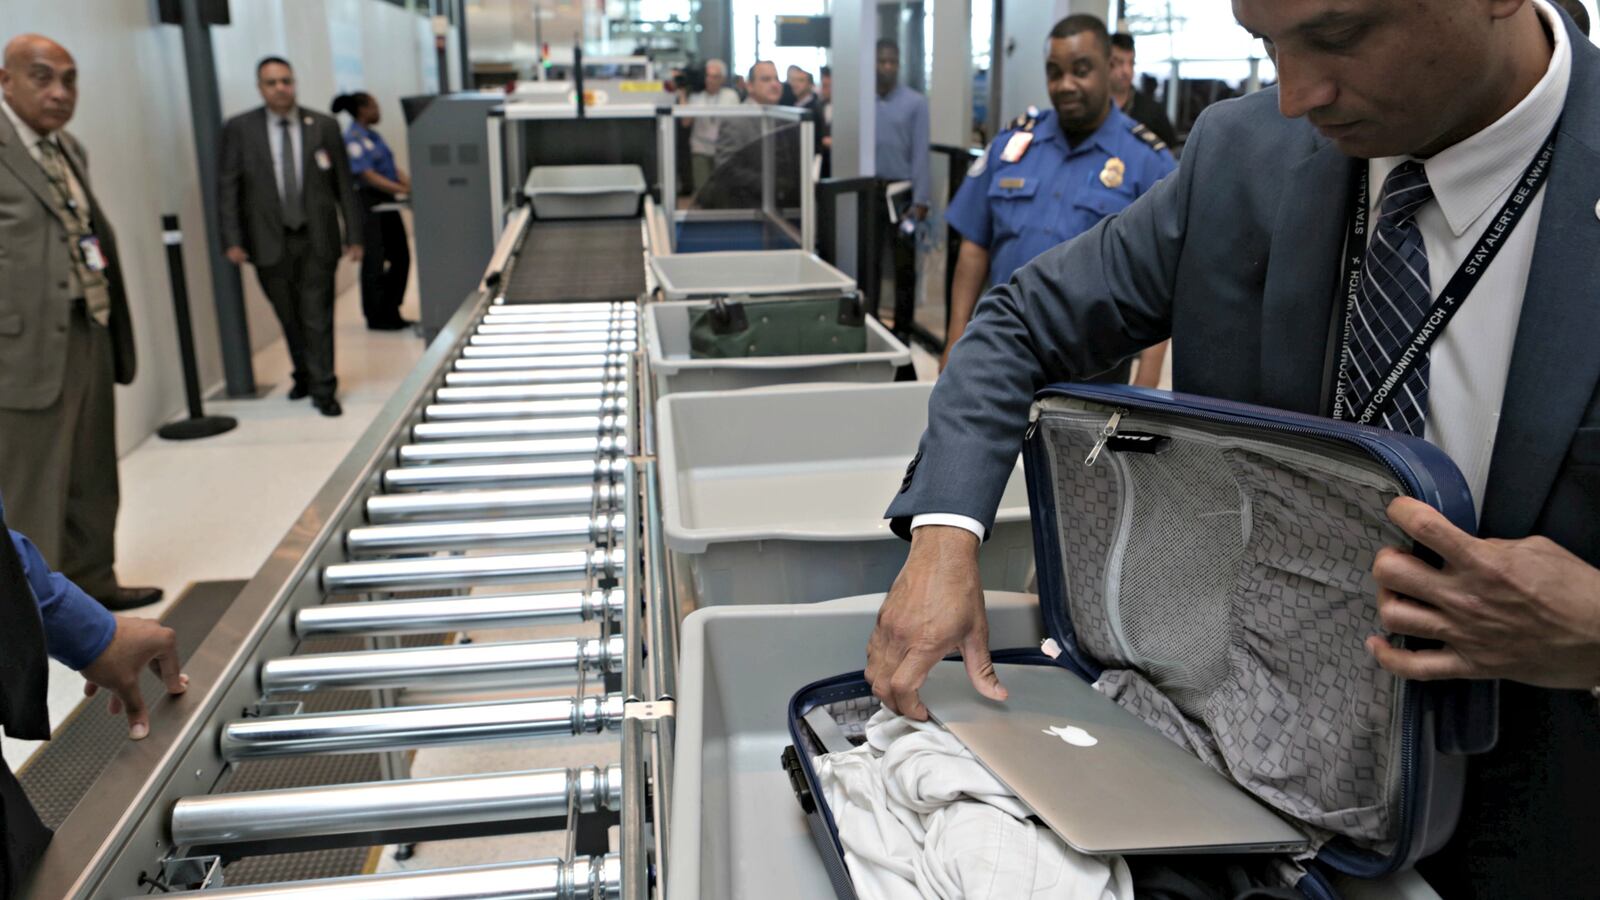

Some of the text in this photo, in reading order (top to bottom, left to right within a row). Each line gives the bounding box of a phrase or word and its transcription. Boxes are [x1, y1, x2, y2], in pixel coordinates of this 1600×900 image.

[1347, 270, 1360, 310] WATCH
[1354, 207, 1365, 235] STAY
[1373, 344, 1419, 404] COMMUNITY
[1414, 308, 1447, 345] WATCH
[1465, 245, 1489, 275] STAY
[1512, 187, 1530, 204] BE
